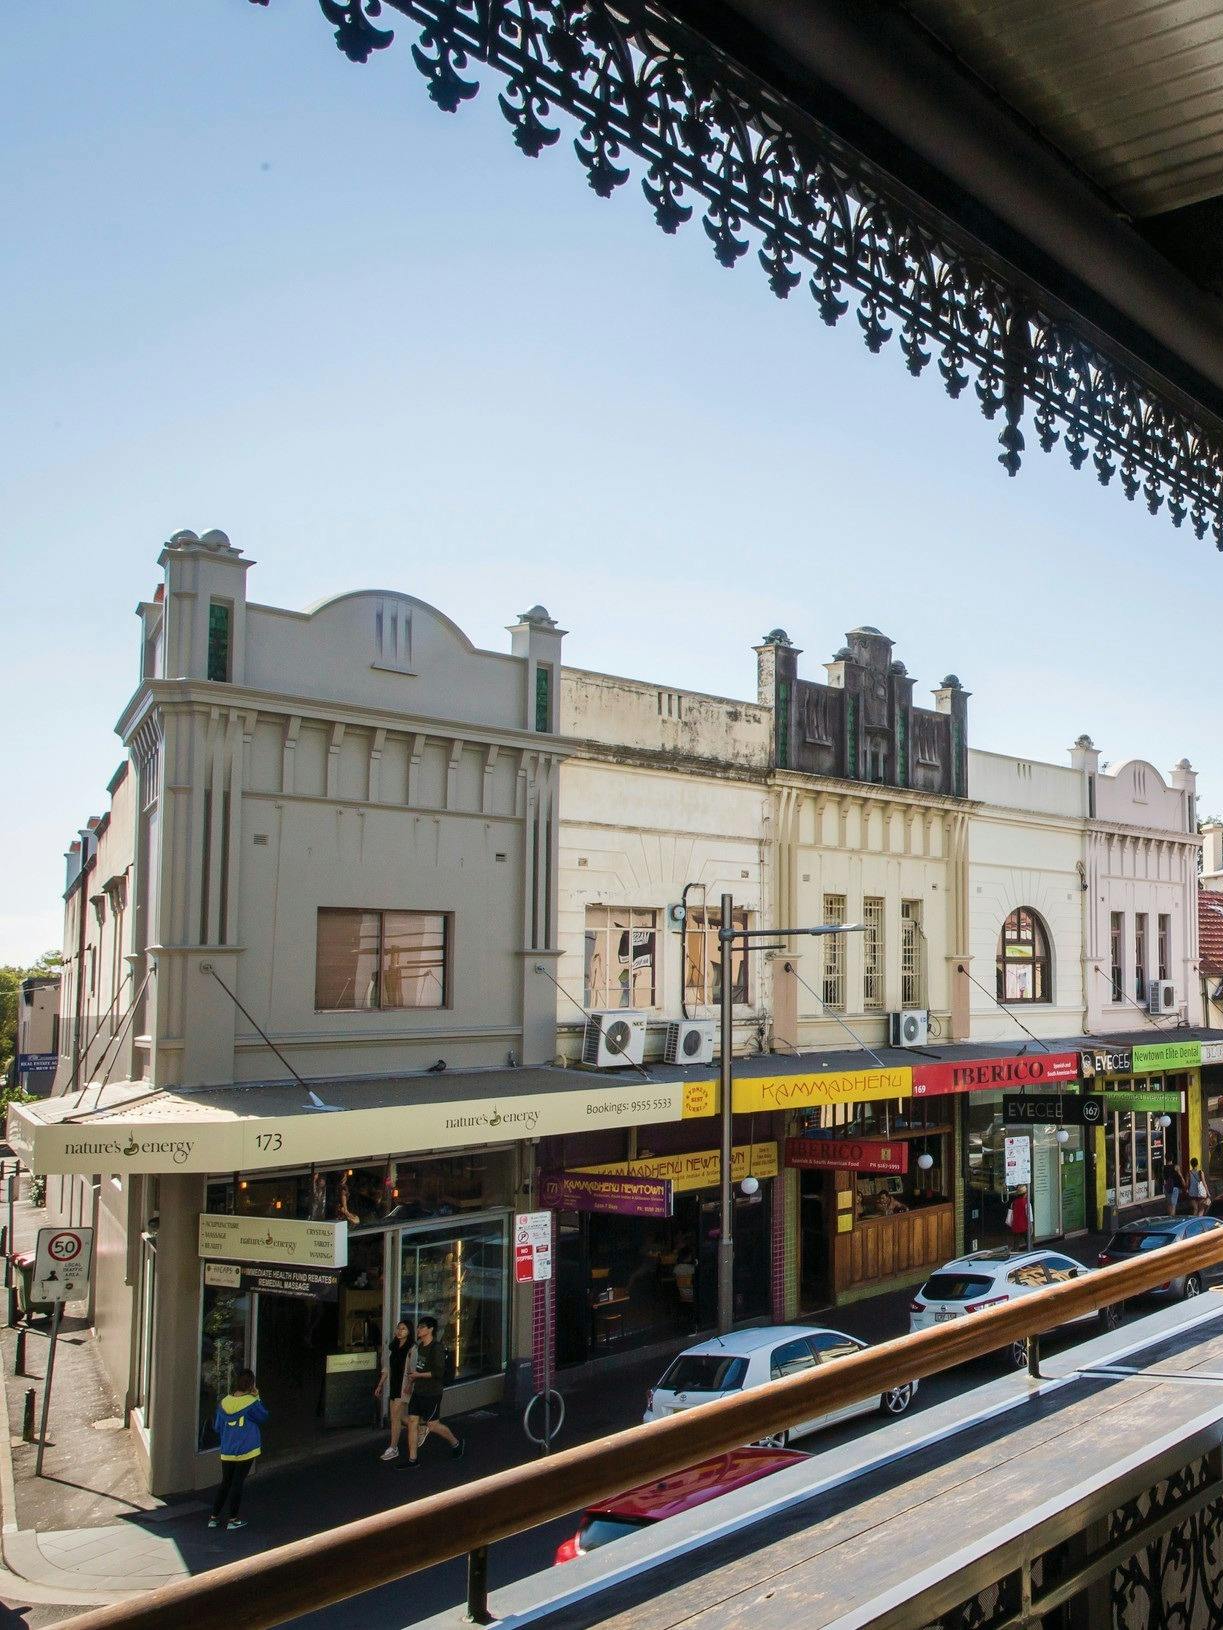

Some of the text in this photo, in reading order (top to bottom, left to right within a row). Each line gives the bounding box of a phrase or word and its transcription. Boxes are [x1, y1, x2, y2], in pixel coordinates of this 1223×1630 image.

[1134, 1050, 1165, 1062] Newtown
[1165, 1047, 1179, 1060] Elite
[1180, 1045, 1199, 1058] Dental
[952, 1061, 1045, 1087] IBERICO
[761, 1074, 902, 1106] KAMMADHENU
[914, 1085, 926, 1094] 169
[586, 1097, 672, 1115] Bookings: 9555 5533
[1085, 1106, 1098, 1116] 167
[445, 1109, 541, 1131] nature's energy
[255, 1133, 283, 1151] 173
[64, 1139, 195, 1164] nature's energy
[791, 1142, 863, 1160] IBERICO
[686, 1151, 745, 1172] NEWTWN
[563, 1179, 664, 1195] KAMMADHENU NEWTOWN
[205, 1231, 227, 1240] MASSAGE
[306, 1228, 331, 1237] CRYSTALS
[54, 1241, 75, 1254] 50
[273, 1240, 298, 1255] energy
[313, 1240, 331, 1248] TAROT
[309, 1251, 331, 1259] WAXING
[273, 1269, 292, 1281] HEALTH
[293, 1272, 307, 1282] FUND
[307, 1273, 332, 1284] REBATES
[258, 1278, 310, 1291] REMEDIAL MASSAGE
